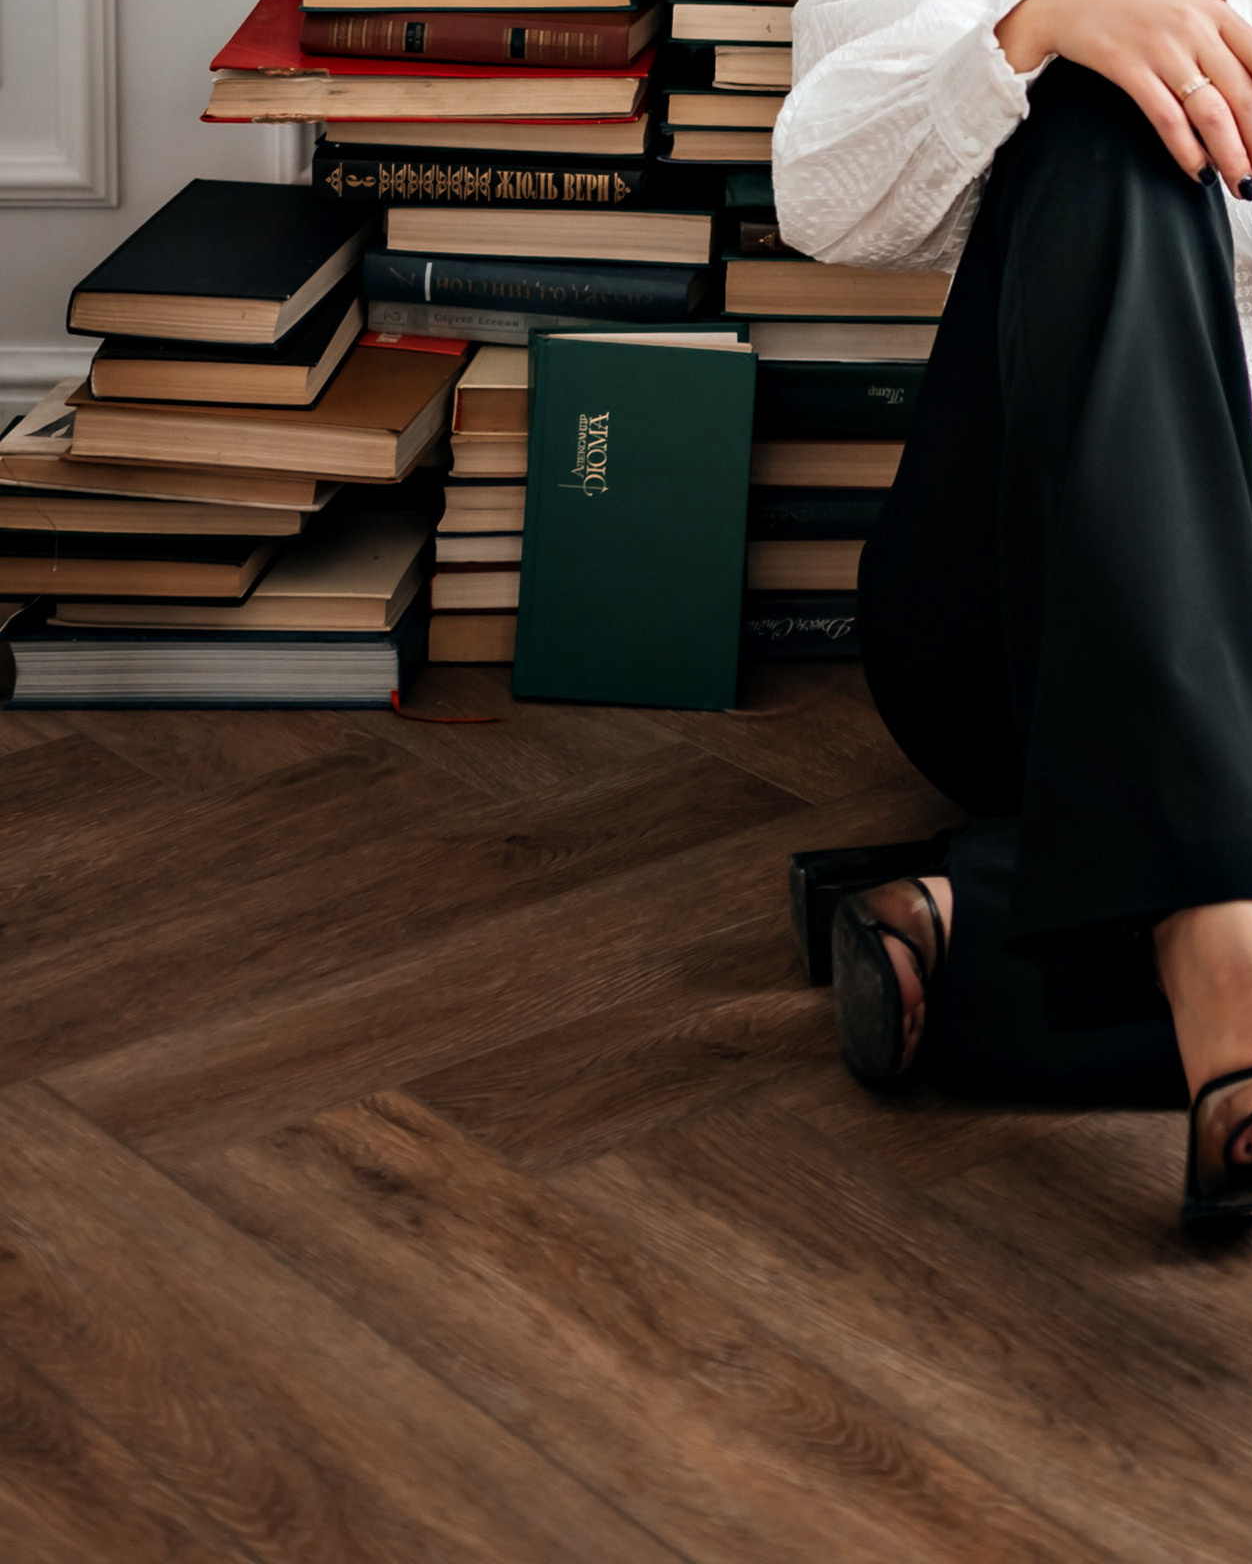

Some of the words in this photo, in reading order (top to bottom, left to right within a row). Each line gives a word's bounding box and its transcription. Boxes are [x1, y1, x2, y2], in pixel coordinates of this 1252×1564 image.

[345, 173, 376, 188] 3
[495, 170, 559, 200] ЖЮЛЬ
[561, 173, 611, 202] ВЕРН
[867, 384, 905, 405] Петр
[563, 411, 610, 497] ДЮМА
